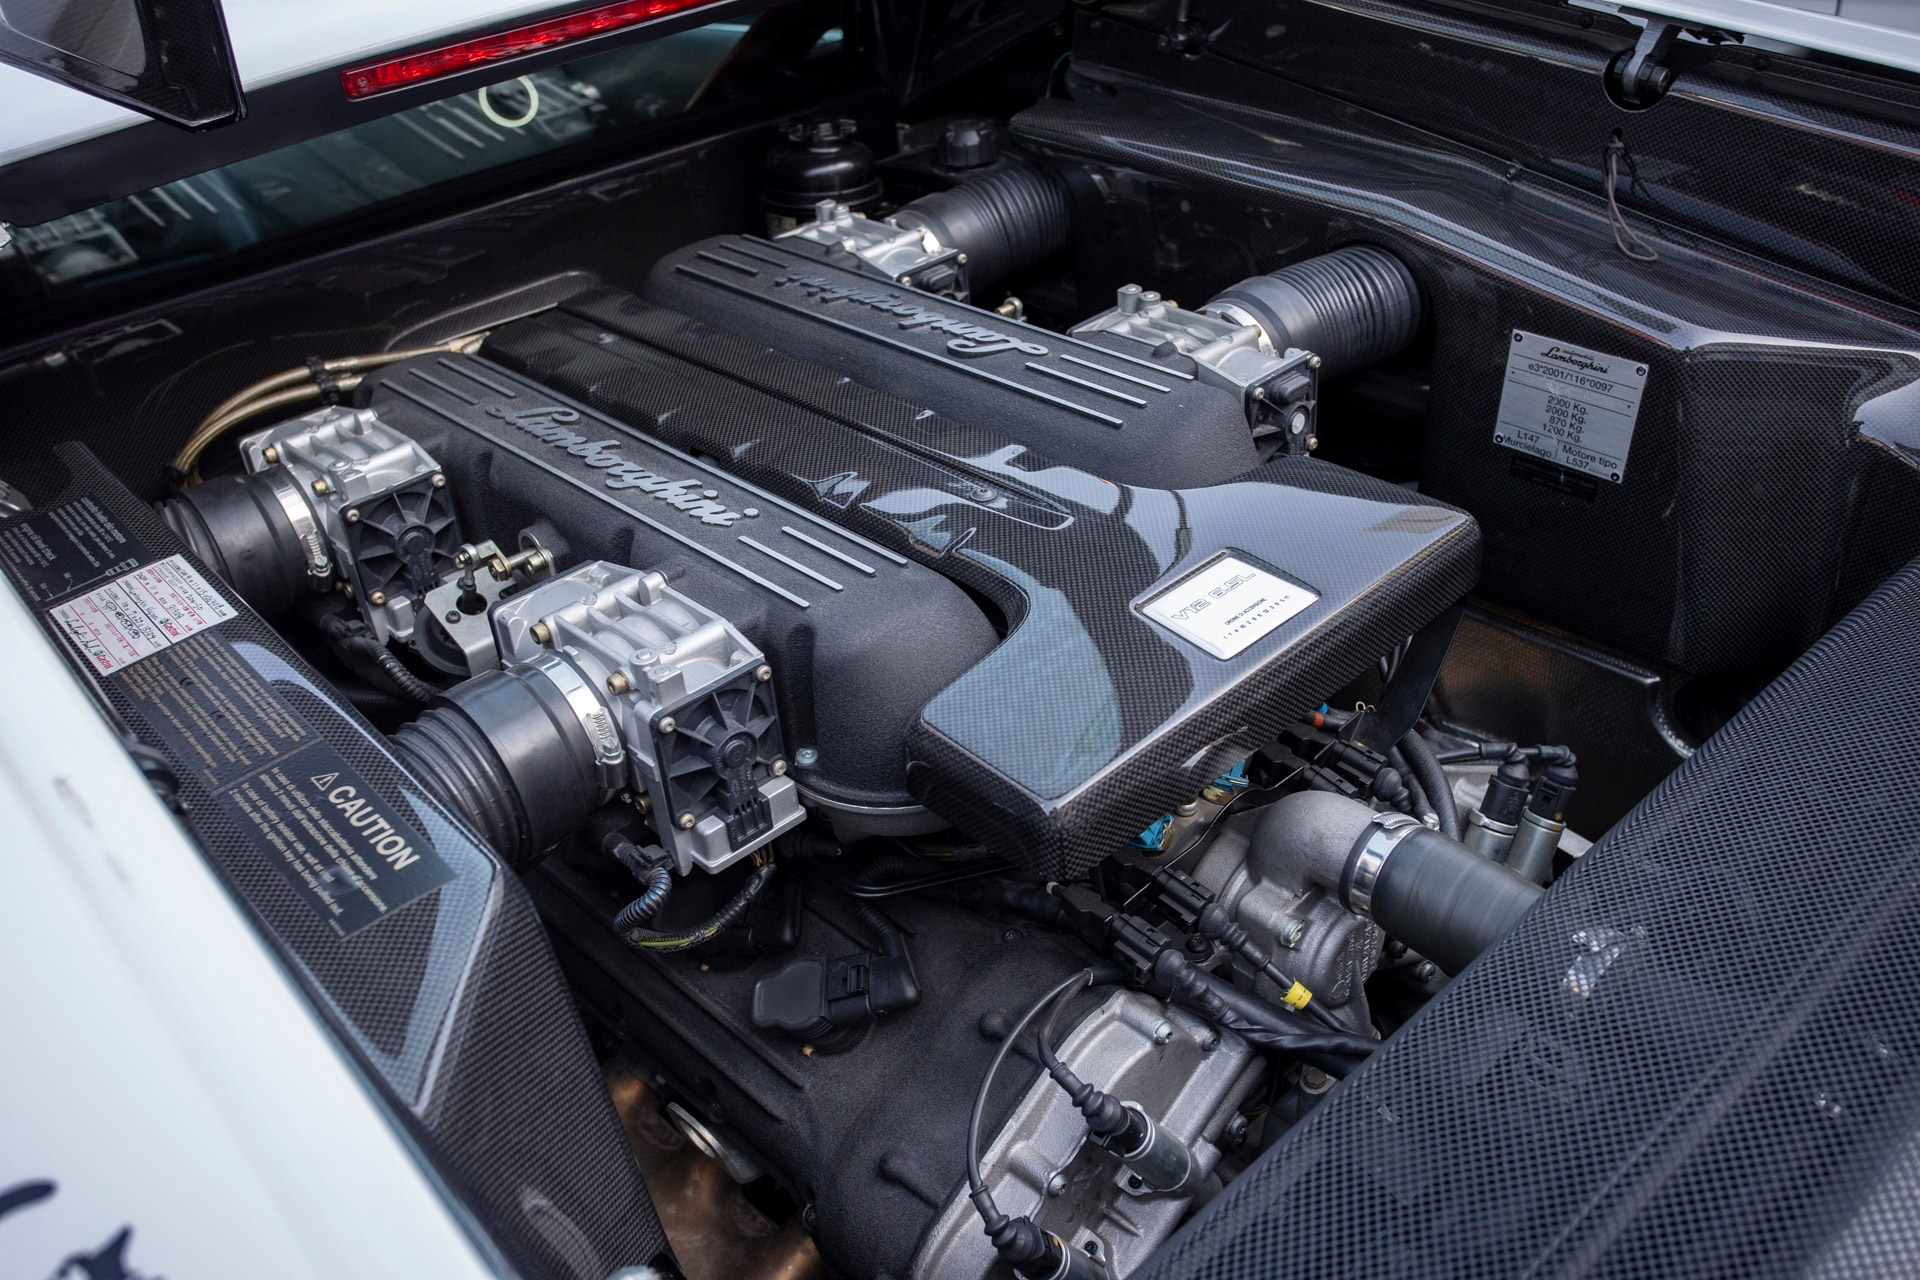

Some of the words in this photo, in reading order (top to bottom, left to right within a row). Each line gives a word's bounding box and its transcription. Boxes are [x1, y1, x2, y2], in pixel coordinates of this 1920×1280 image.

[774, 273, 1049, 357] Lamborghini
[1540, 347, 1610, 374] Lamborghini
[1548, 396, 1571, 409] 2000
[1573, 401, 1588, 415] Kg.
[1545, 406, 1568, 419] 2000
[1571, 411, 1586, 425] Kg.
[1549, 416, 1567, 428] 870
[1569, 420, 1584, 433] Kg.
[1517, 430, 1540, 444] L147
[1542, 423, 1565, 437] 1200
[1567, 430, 1582, 443] Kg.
[1503, 435, 1552, 458] Murcielago
[484, 405, 760, 528] Lamborghini
[1563, 445, 1596, 463] Motore
[1599, 456, 1618, 470] tipo
[1566, 458, 1589, 470] L537
[109, 528, 127, 543] motore
[41, 546, 58, 561] check
[1172, 598, 1211, 620] V12
[161, 620, 182, 637] Castrol
[95, 653, 115, 669] Castrol
[274, 771, 291, 785] caso
[285, 783, 296, 791] di
[244, 786, 261, 800] case
[255, 798, 266, 806] of
[290, 788, 312, 807] utilizzo
[260, 804, 282, 823] battery
[305, 805, 323, 820] dello
[258, 772, 279, 792] almeno
[277, 793, 297, 810] minuti
[322, 843, 341, 859] della
[334, 856, 356, 876] chiave
[275, 821, 299, 842] isolator
[328, 785, 420, 871] CAUTION
[317, 817, 356, 855] staccabatteria
[231, 792, 254, 813] minutes
[247, 810, 264, 825] after
[257, 822, 271, 832] the
[264, 830, 288, 852] ignition
[281, 849, 297, 862] key
[290, 859, 306, 872] has
[299, 869, 320, 887] being
[312, 884, 334, 904] pulled
[327, 901, 345, 916] out.
[302, 851, 320, 865] wait
[312, 862, 325, 871] at
[350, 852, 380, 880] attendere
